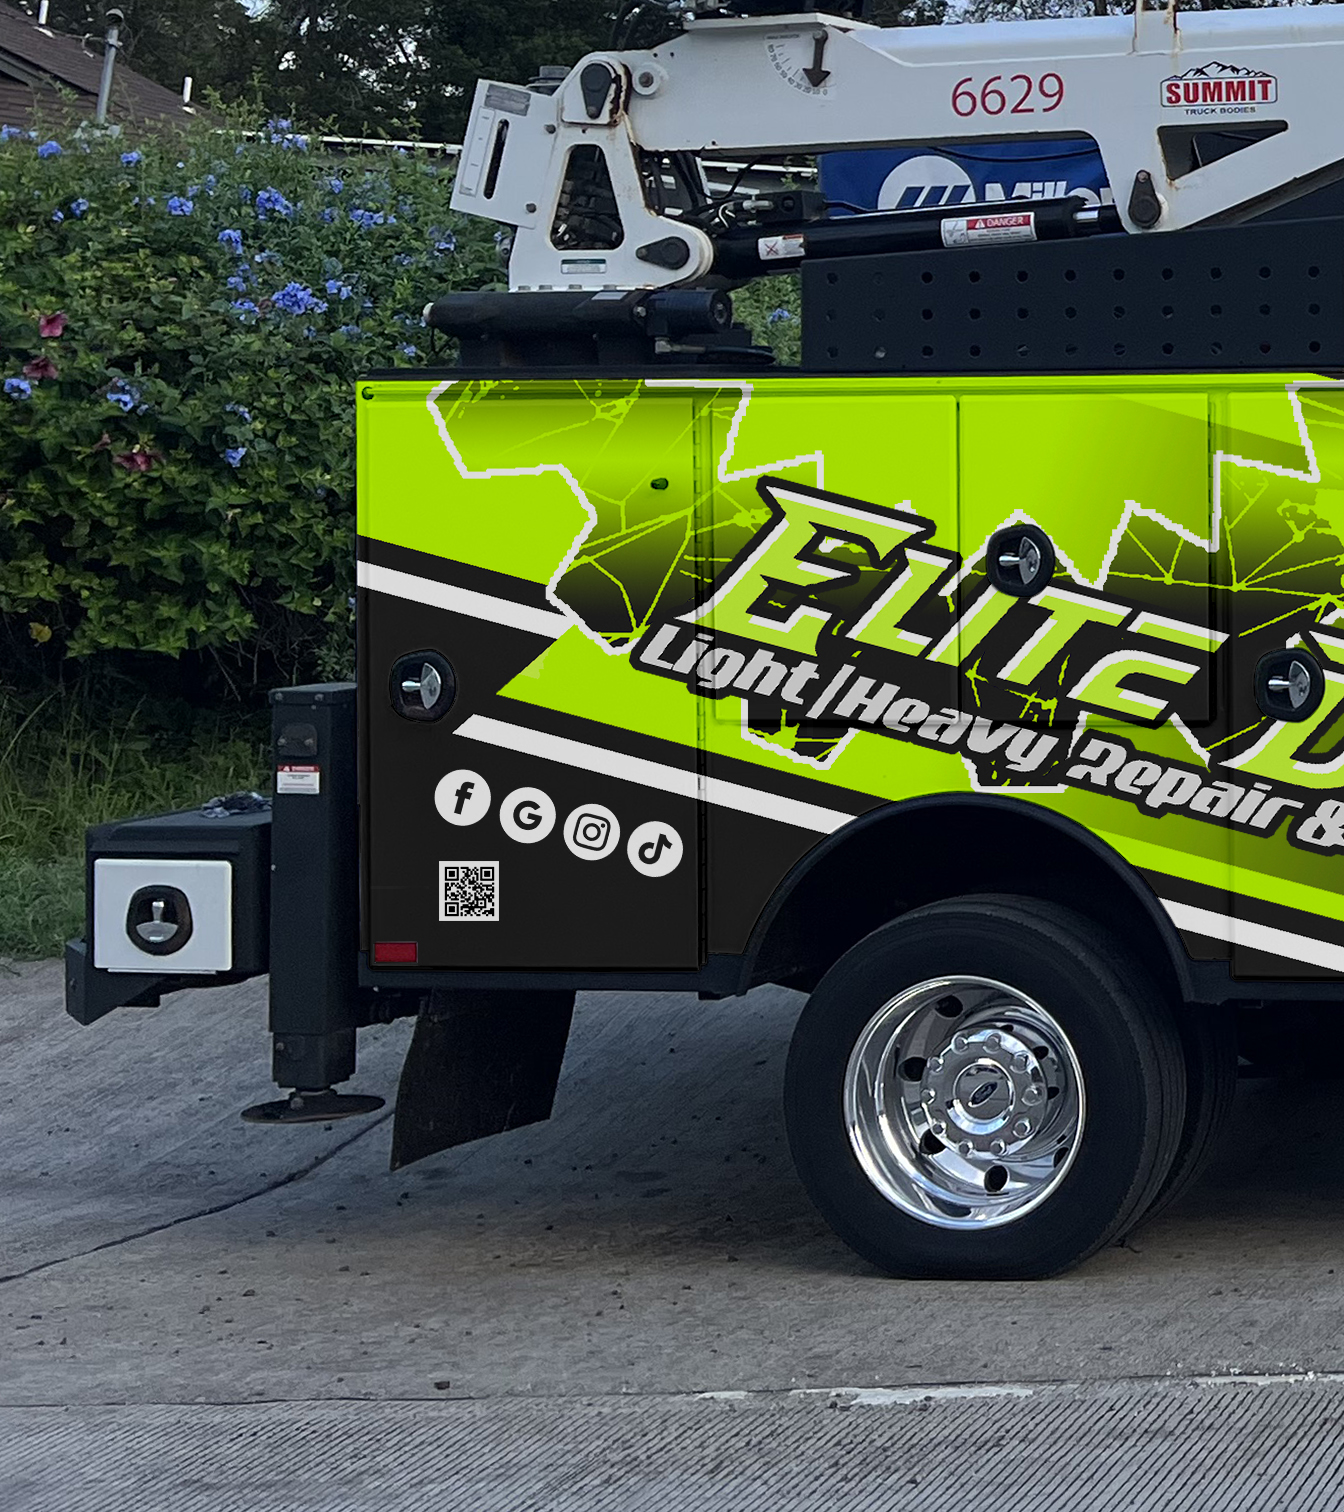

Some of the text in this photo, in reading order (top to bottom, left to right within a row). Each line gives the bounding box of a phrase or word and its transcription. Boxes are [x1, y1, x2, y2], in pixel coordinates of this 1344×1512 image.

[952, 73, 1065, 116] 6629
[1166, 80, 1272, 104] SUMMIT
[1184, 106, 1257, 115] TRUCK BODIES
[986, 216, 1024, 227] DANGER
[675, 486, 1230, 719] ELITE
[1066, 740, 1304, 829] Repair
